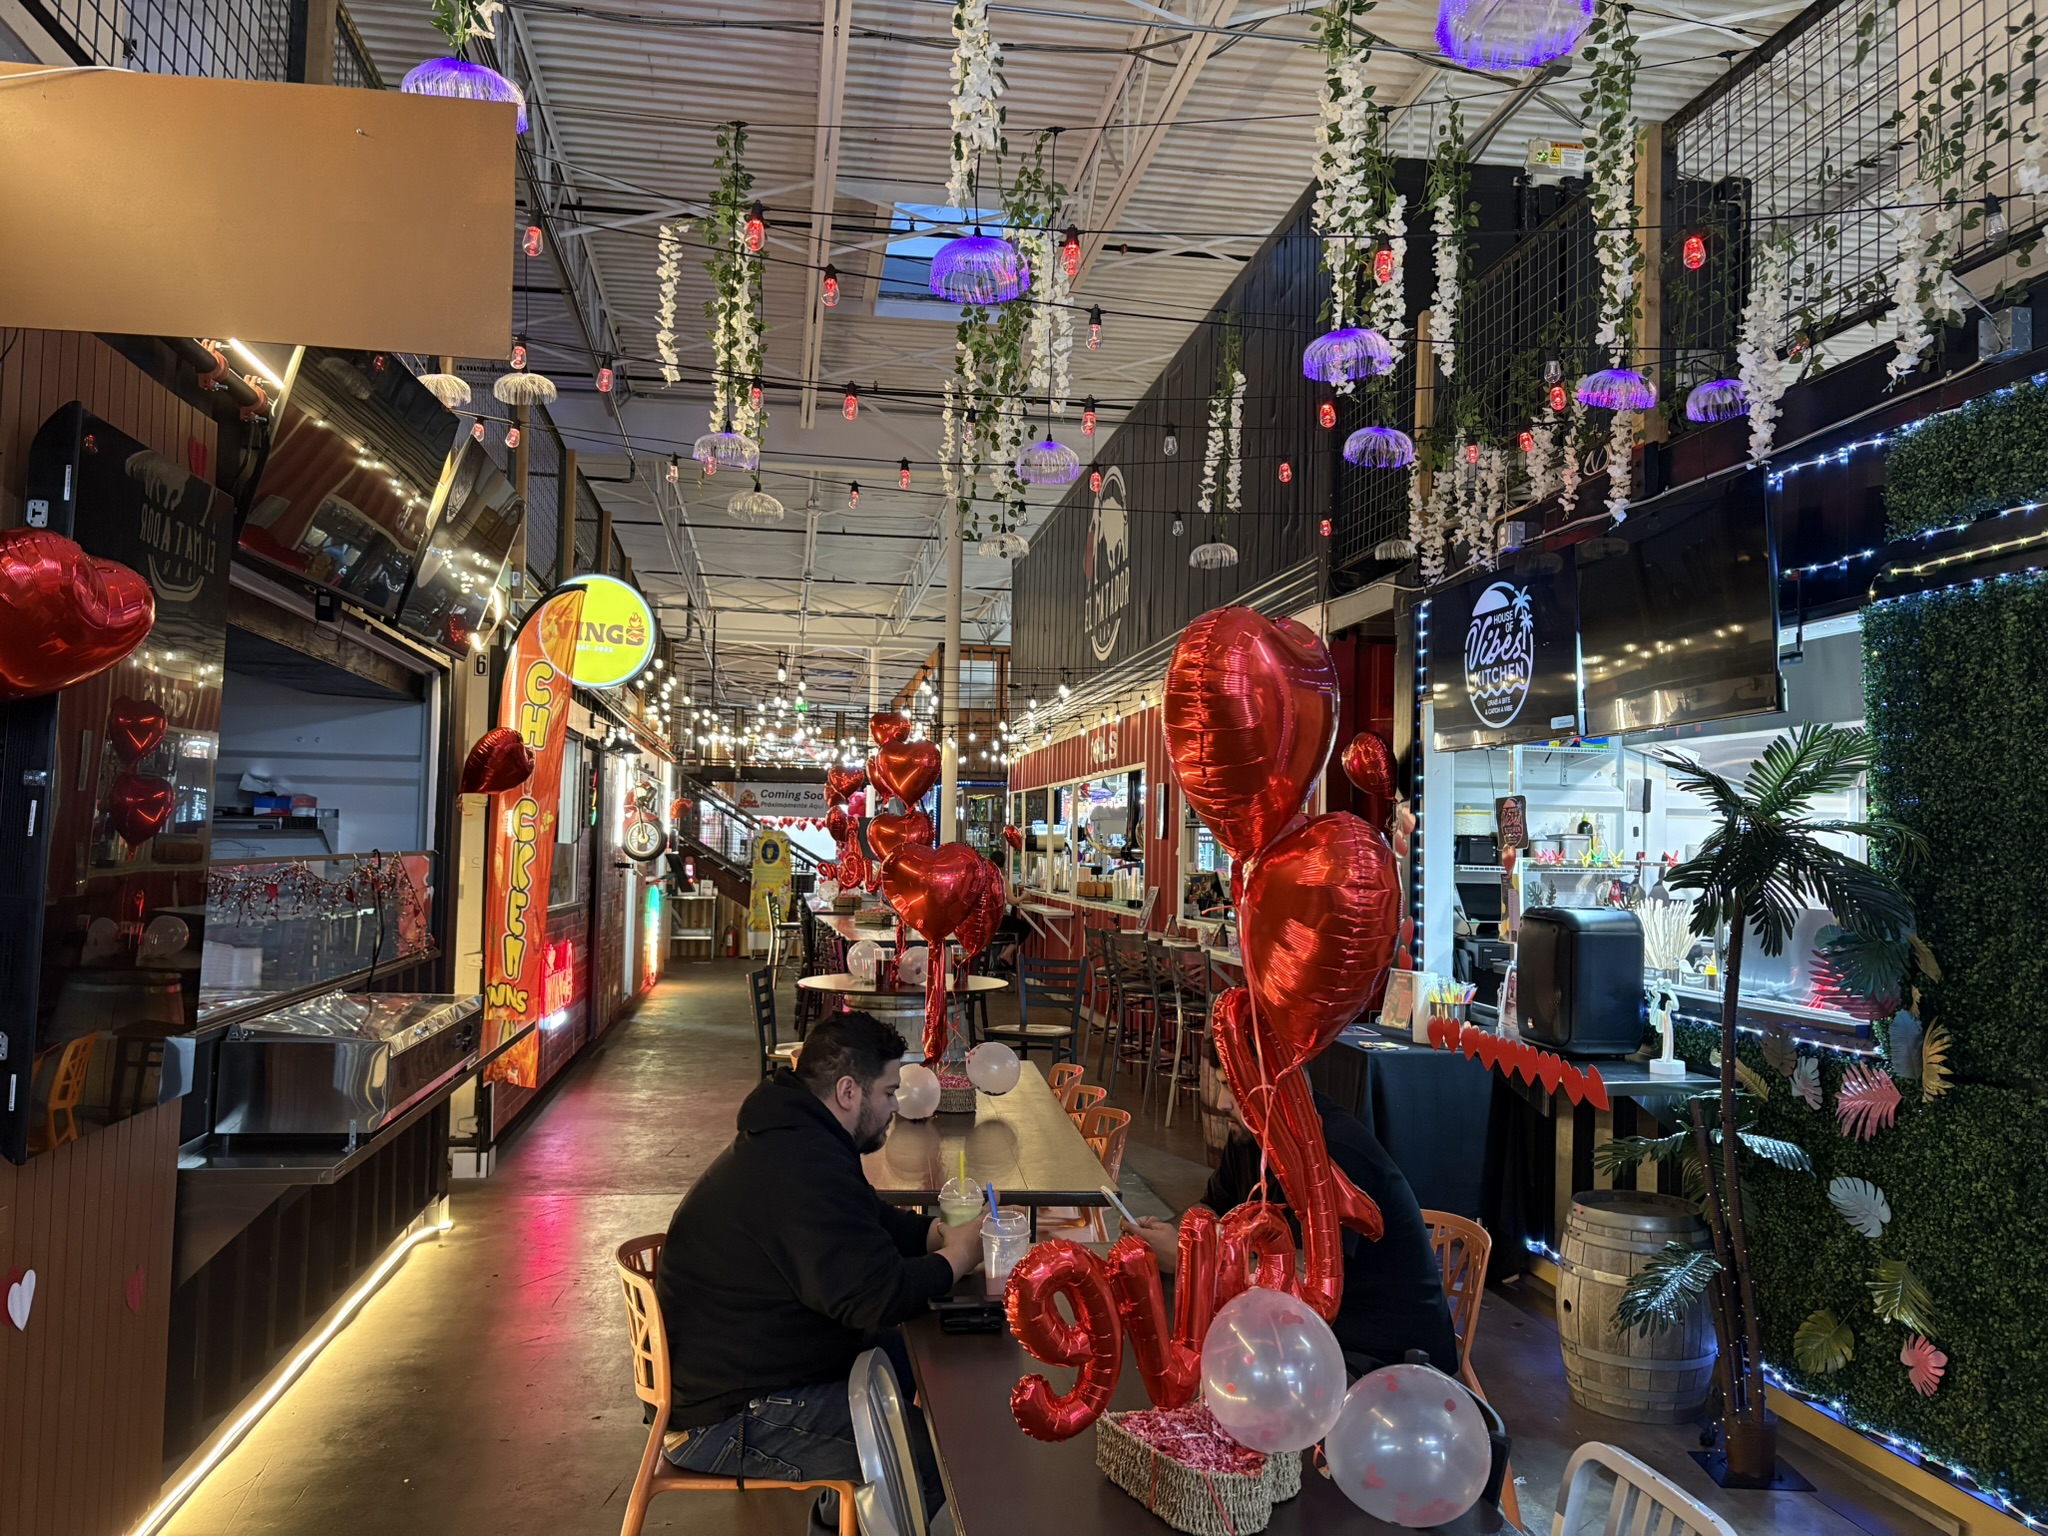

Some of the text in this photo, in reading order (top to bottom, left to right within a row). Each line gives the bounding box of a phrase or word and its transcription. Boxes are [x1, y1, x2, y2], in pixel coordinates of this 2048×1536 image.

[1094, 566, 1130, 627] MATADOR
[1493, 610, 1514, 625] HOUSE
[1505, 621, 1514, 632] OF
[1465, 615, 1523, 671] Vibes
[476, 654, 487, 675] 6
[1474, 661, 1524, 687] KITCHEN
[761, 789, 825, 802] Coming Soo
[504, 661, 554, 981] CHCKEN
